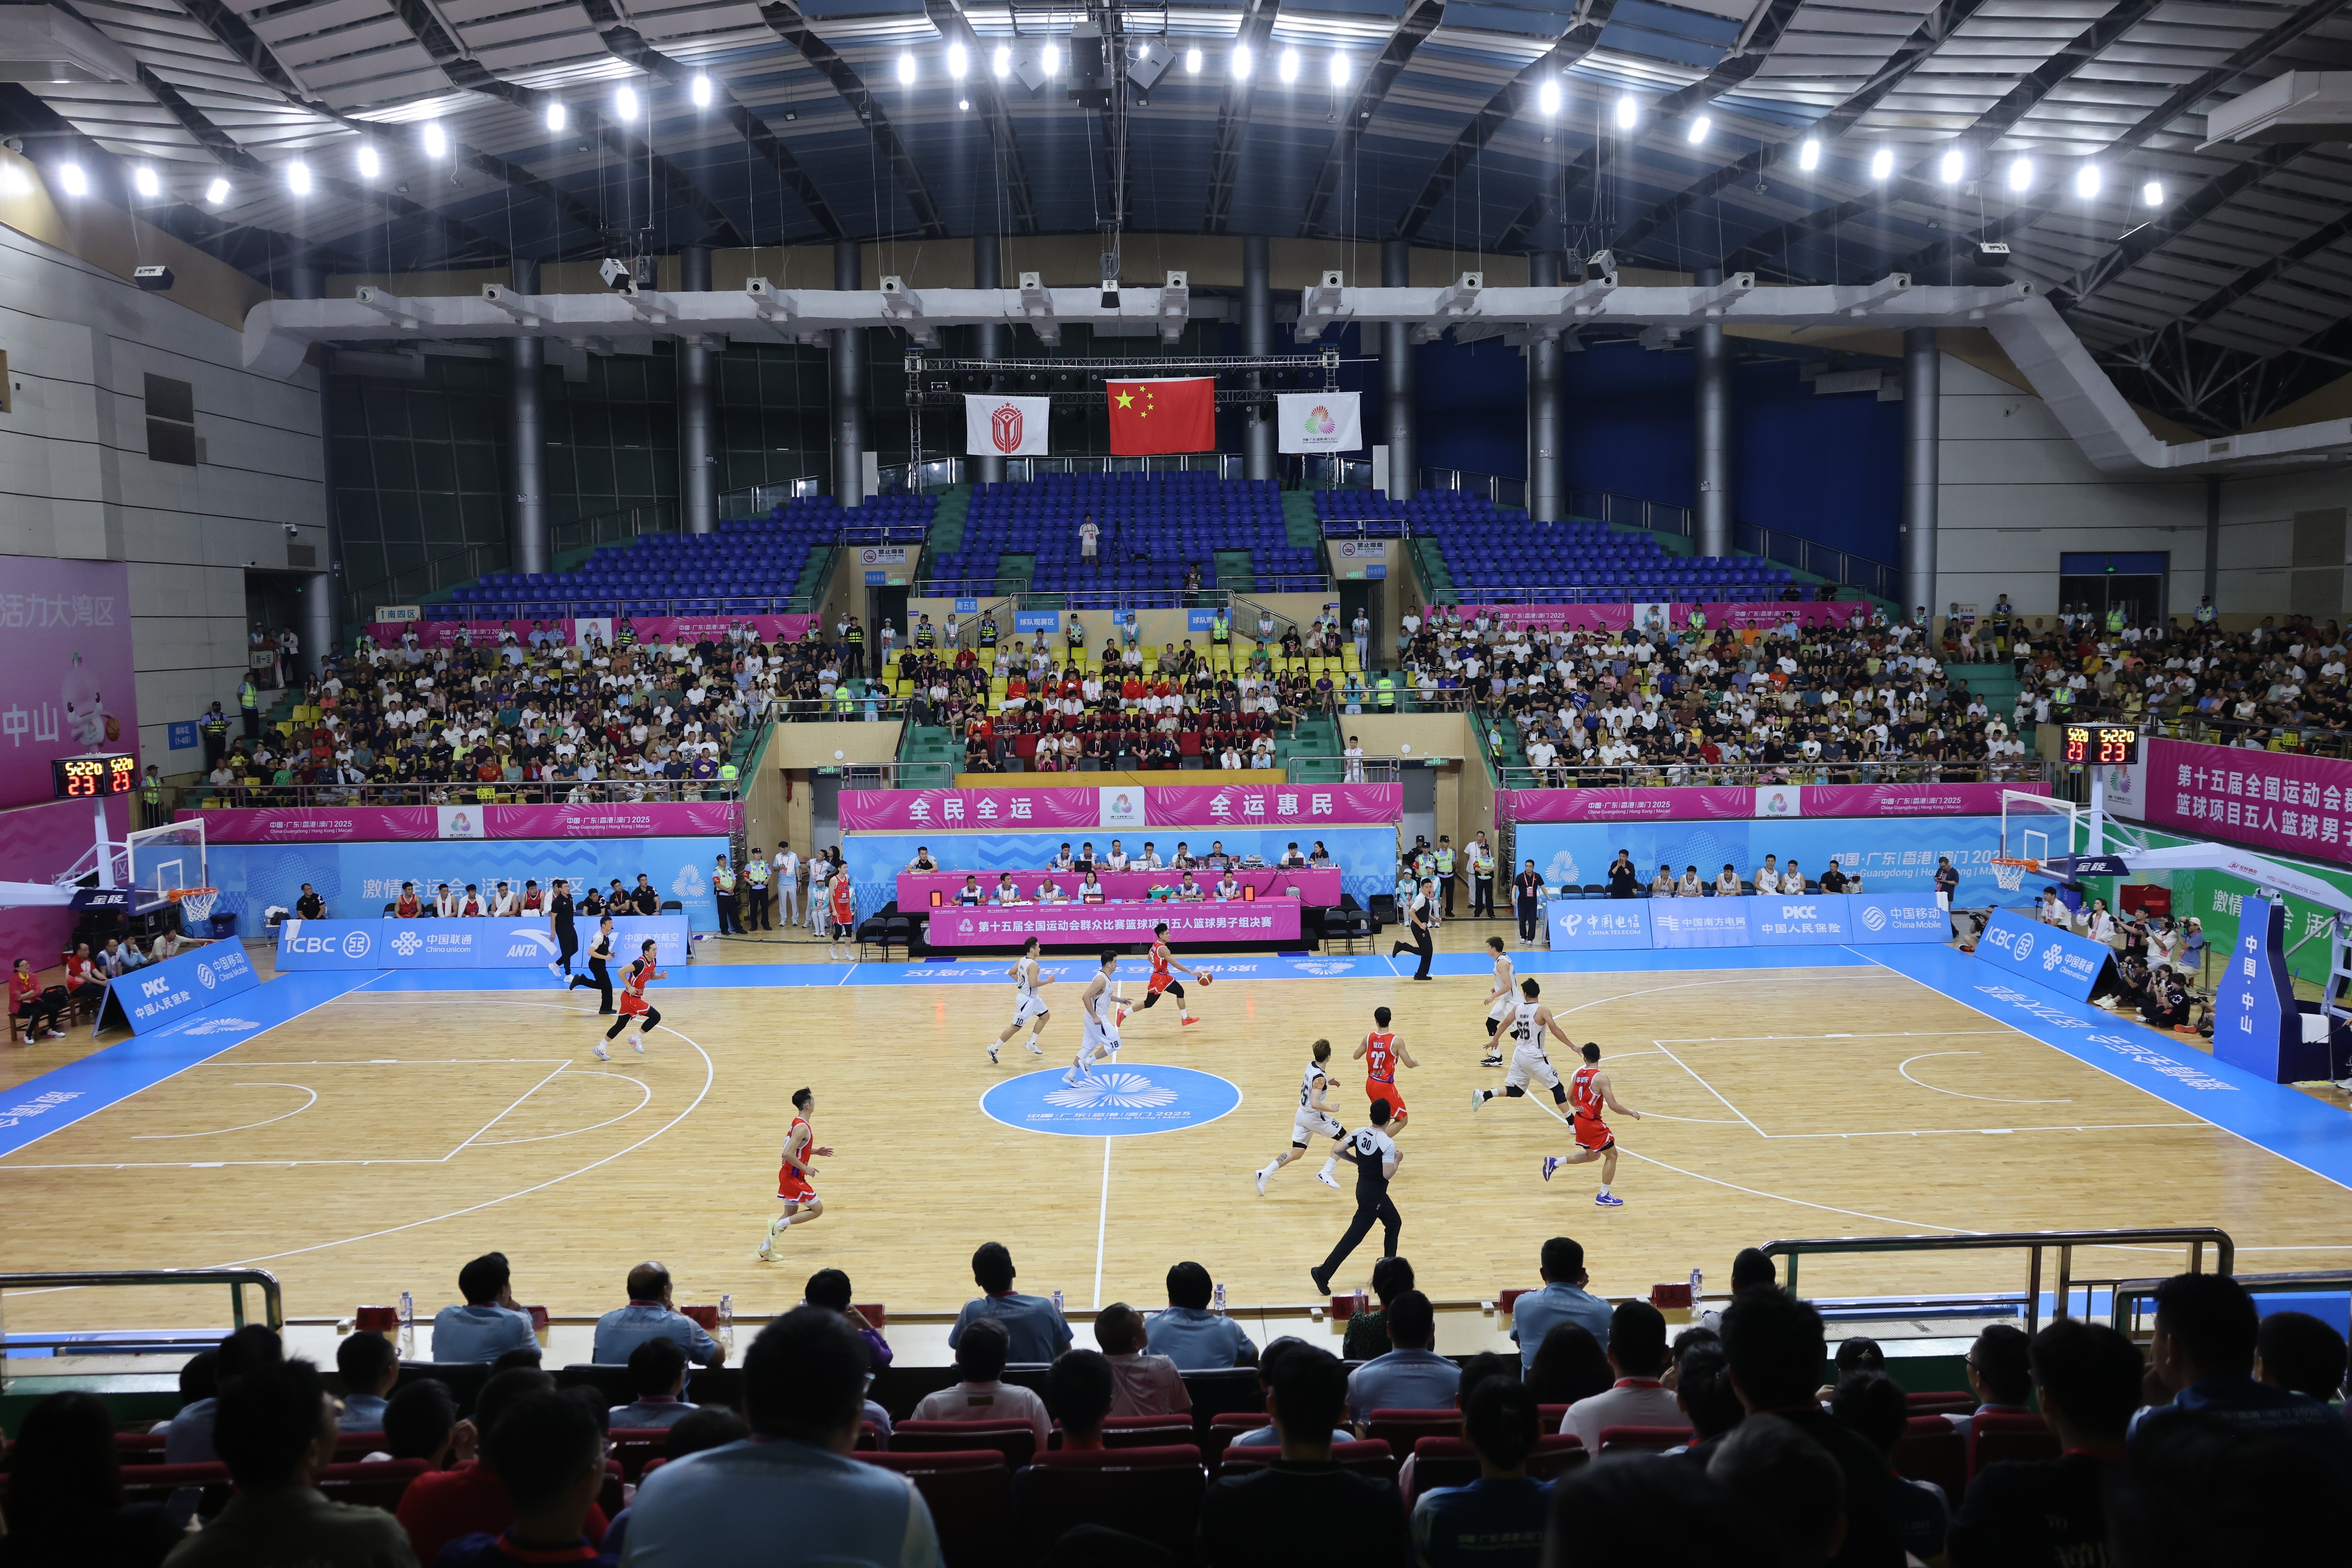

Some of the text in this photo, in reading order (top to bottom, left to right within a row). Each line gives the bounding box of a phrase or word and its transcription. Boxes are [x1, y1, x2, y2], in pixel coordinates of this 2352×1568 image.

[0, 593, 114, 628] 活力大湾区
[388, 609, 415, 618] 南四区
[957, 601, 976, 610] 南五区
[2, 702, 59, 747] 中山
[2068, 741, 2083, 761] 23
[2101, 743, 2125, 761] 23
[68, 775, 95, 796] 23
[113, 771, 130, 792] 23
[908, 797, 1032, 820] 全民全运
[1209, 793, 1332, 816] 全运惠民
[2076, 863, 2110, 871] 金陵
[90, 895, 126, 905] 金陵
[1783, 905, 1817, 919] PICC
[1891, 907, 1940, 920] 中国移动
[1587, 914, 1640, 930] 中国电信
[1682, 917, 1746, 927] 中国南方电网
[1762, 922, 1841, 934] 中国人民保险
[286, 937, 336, 953] ICBC
[426, 934, 472, 945] 中国联通
[625, 933, 679, 943] 中国南方航空
[1986, 926, 2016, 950] ICBC
[506, 944, 537, 957] ANTA
[212, 952, 244, 972] 中国移动
[2064, 953, 2095, 974] 中国联通
[219, 965, 249, 982] China Mobile
[2060, 966, 2088, 982] China unicom
[141, 976, 170, 999] PICC
[134, 990, 191, 1020] 中国人民保险
[1517, 1021, 1530, 1040] 66
[1361, 1137, 1372, 1151] 30
